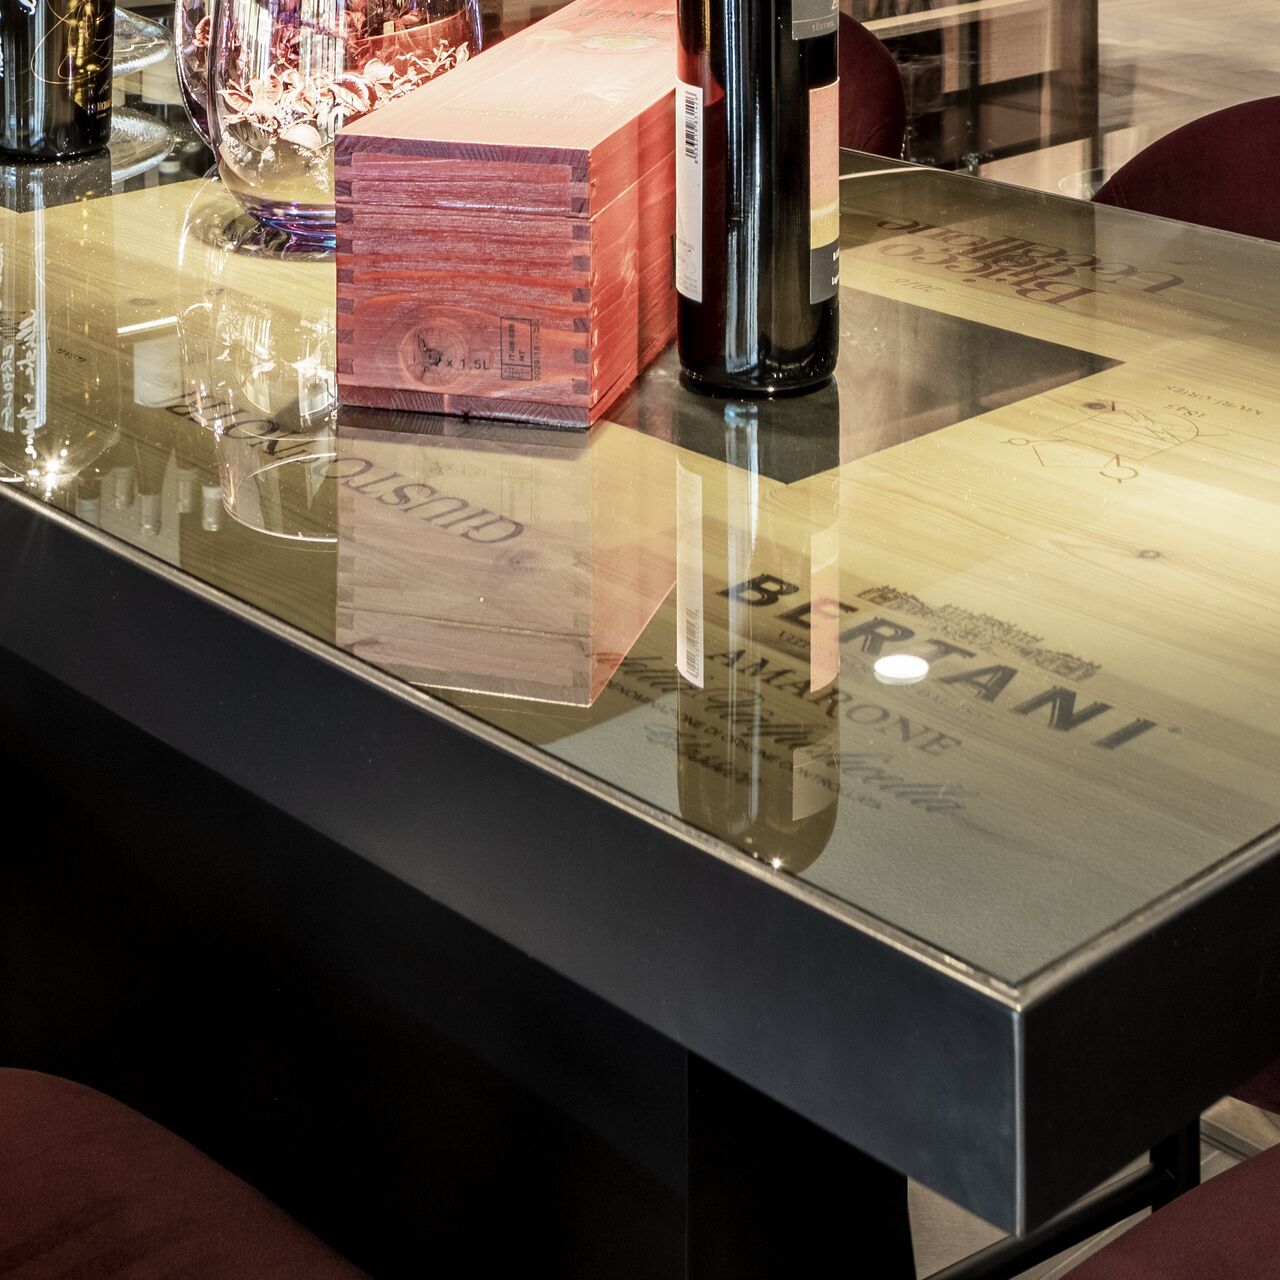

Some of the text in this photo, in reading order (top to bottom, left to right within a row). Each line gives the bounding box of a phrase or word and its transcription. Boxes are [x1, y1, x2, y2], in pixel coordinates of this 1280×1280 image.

[877, 241, 1098, 307] Bricco
[460, 359, 490, 370] 1.5L
[323, 456, 526, 544] GIUSTO
[708, 649, 963, 757] AMARONE
[715, 573, 1159, 750] BERTANI
